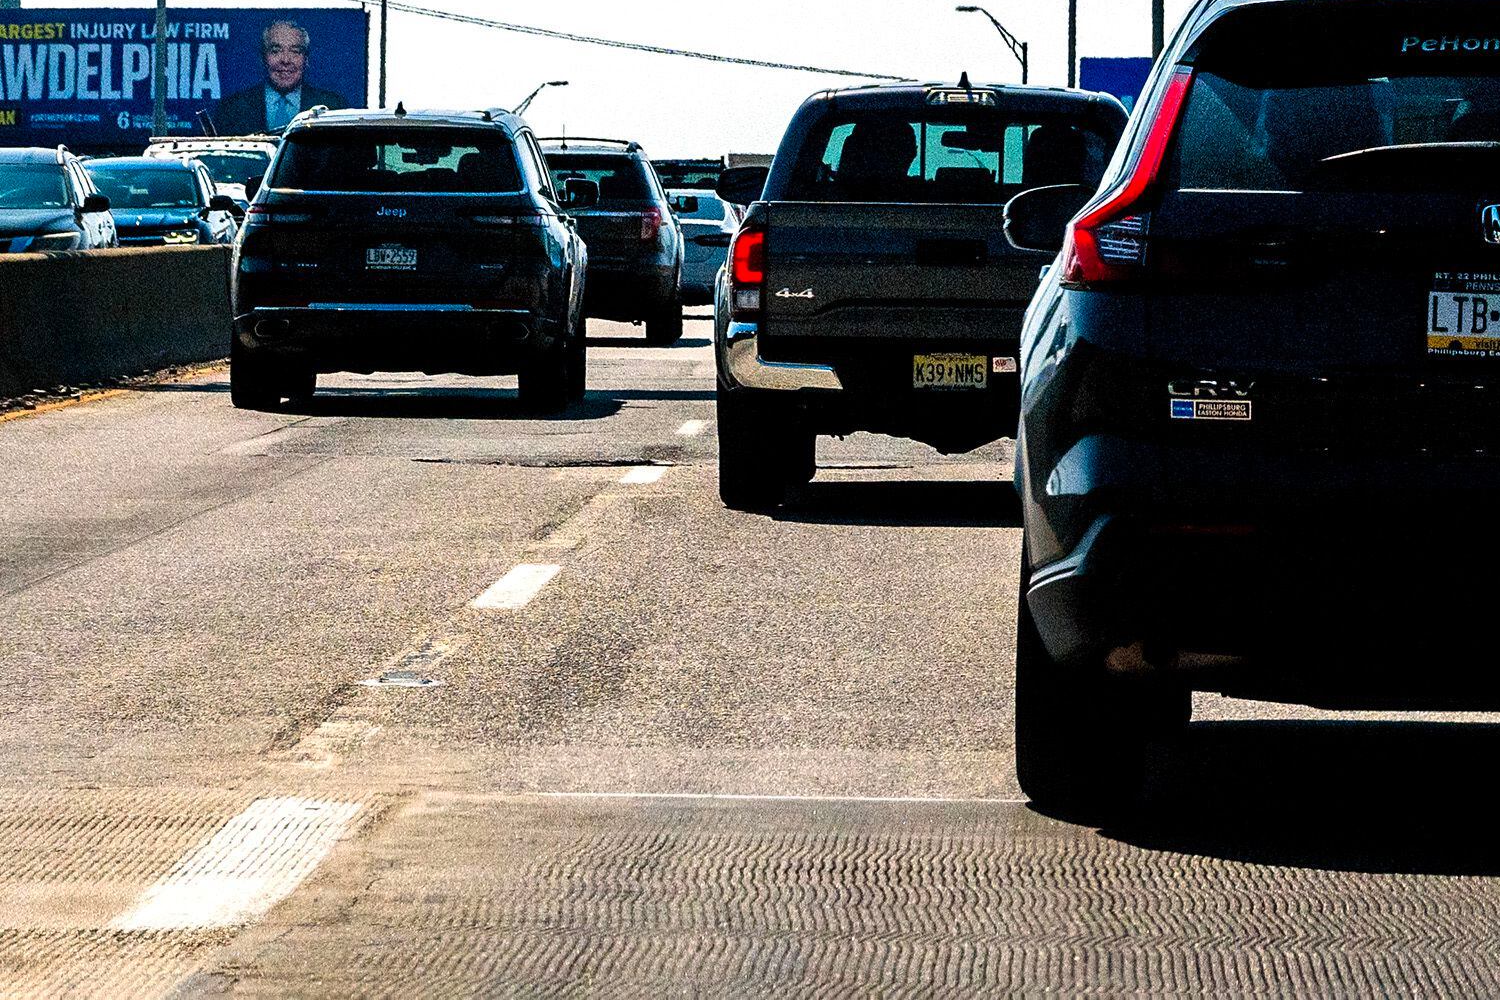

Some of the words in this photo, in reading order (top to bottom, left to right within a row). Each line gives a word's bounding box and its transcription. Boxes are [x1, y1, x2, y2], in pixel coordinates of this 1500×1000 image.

[70, 23, 136, 39] INJURY
[185, 22, 229, 39] FIRM
[0, 43, 221, 99] WDELPHIA
[117, 111, 130, 129] 6
[377, 206, 407, 217] Jeep
